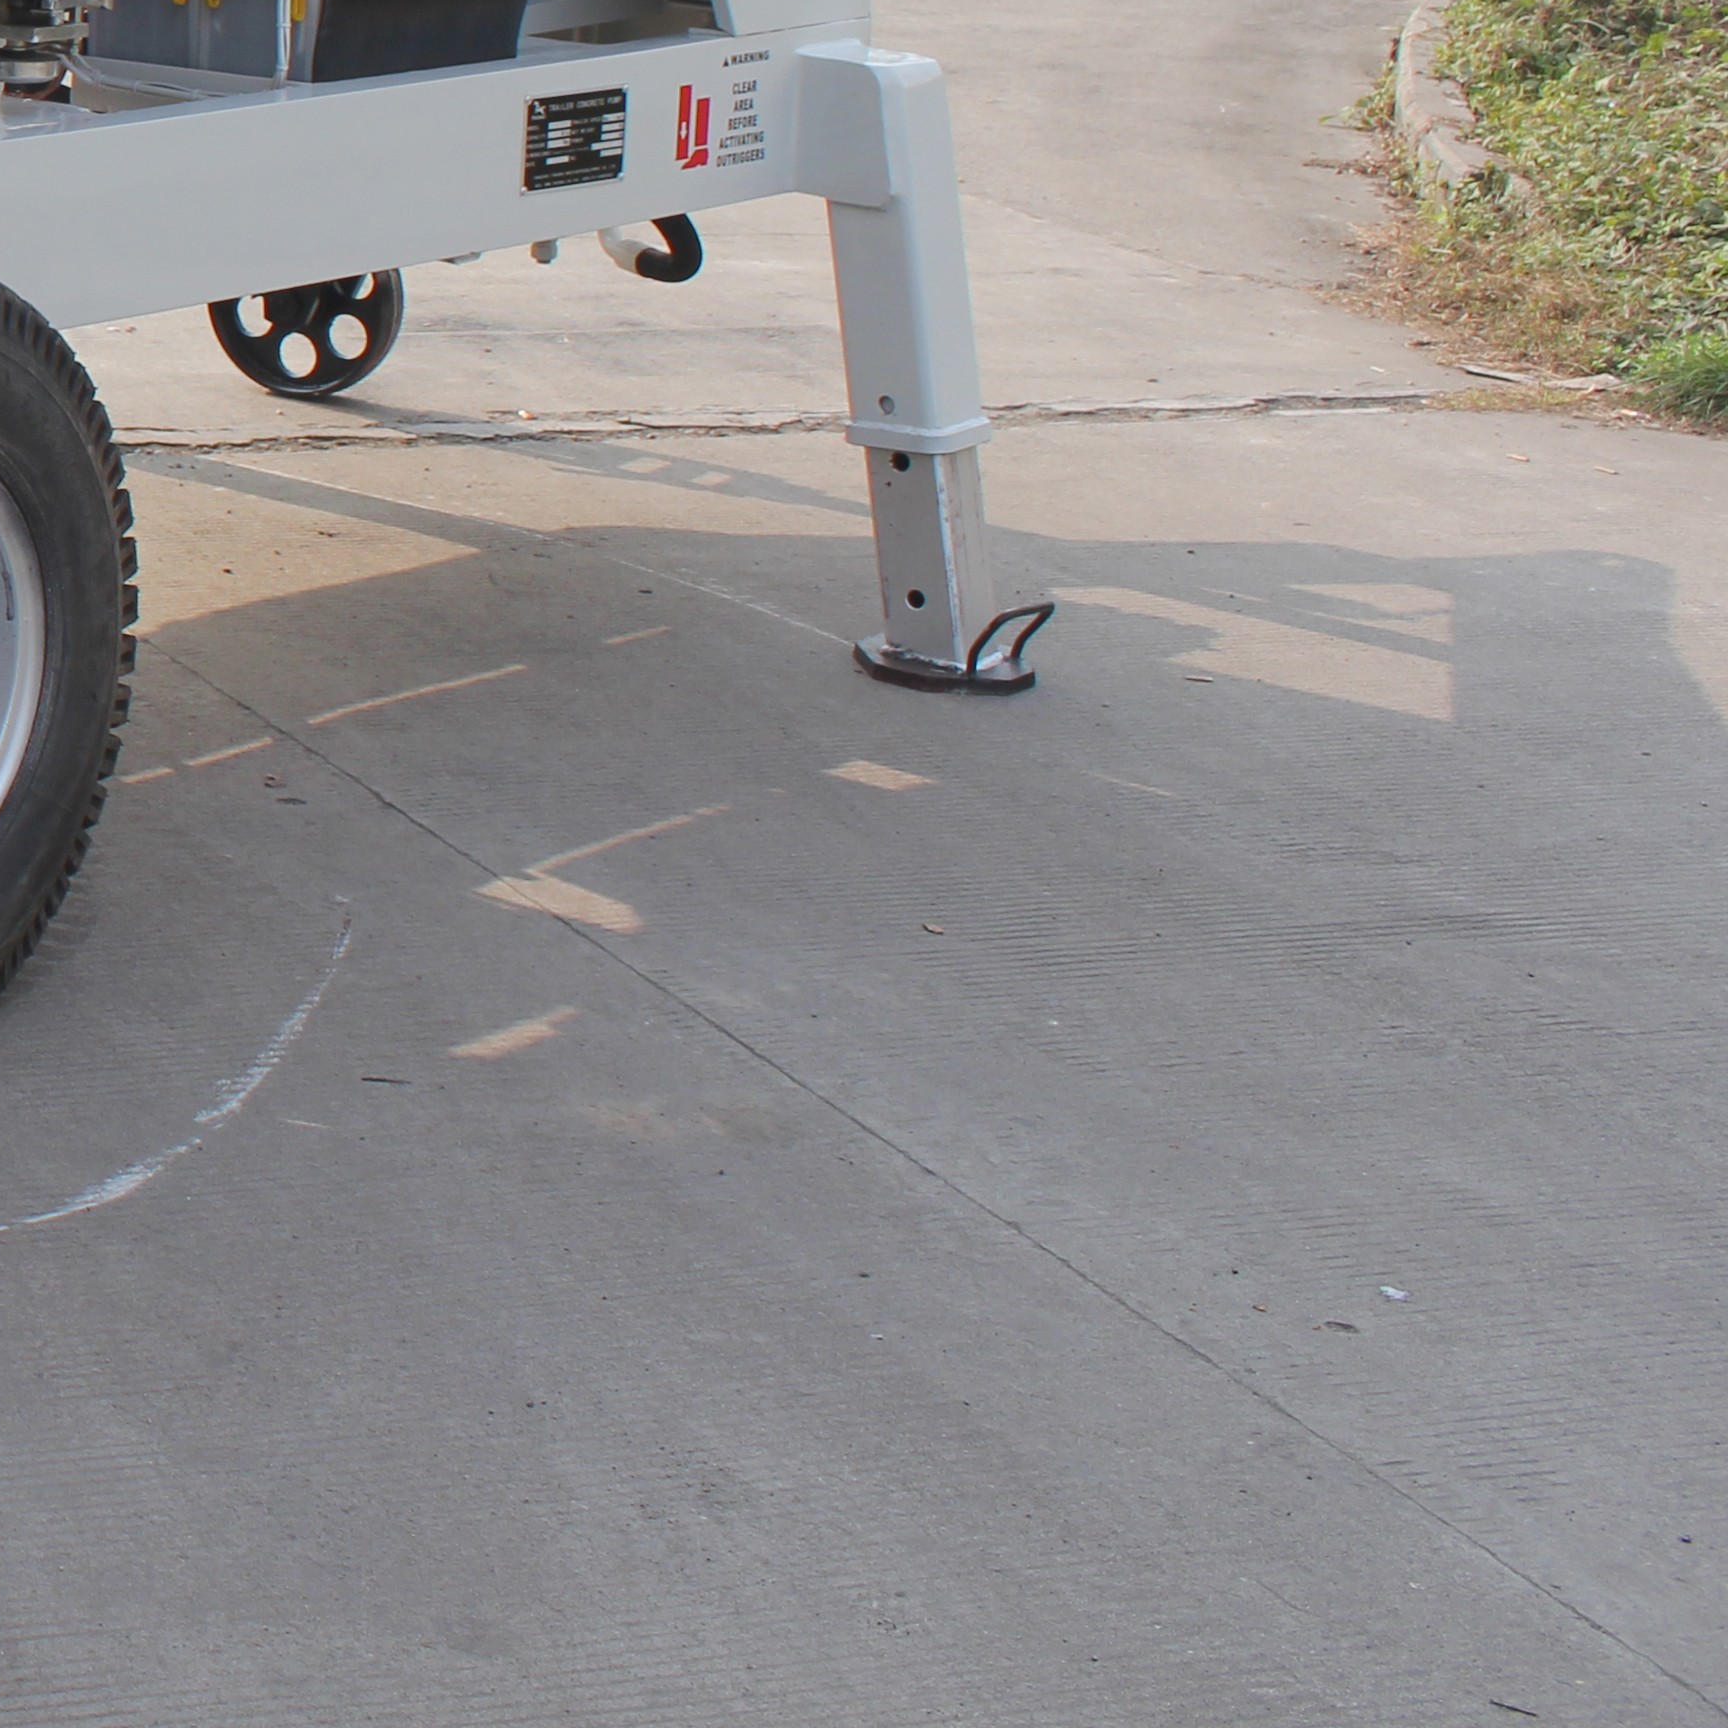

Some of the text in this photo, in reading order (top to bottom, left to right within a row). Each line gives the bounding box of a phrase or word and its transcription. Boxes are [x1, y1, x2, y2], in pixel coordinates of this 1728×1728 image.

[730, 50, 770, 65] WARNING
[732, 80, 757, 95] CLEAR
[733, 98, 754, 112] AREA
[727, 114, 757, 131] BEFORE
[719, 131, 764, 150] ACTIVATING
[716, 148, 765, 168] OUTRIGGERS
